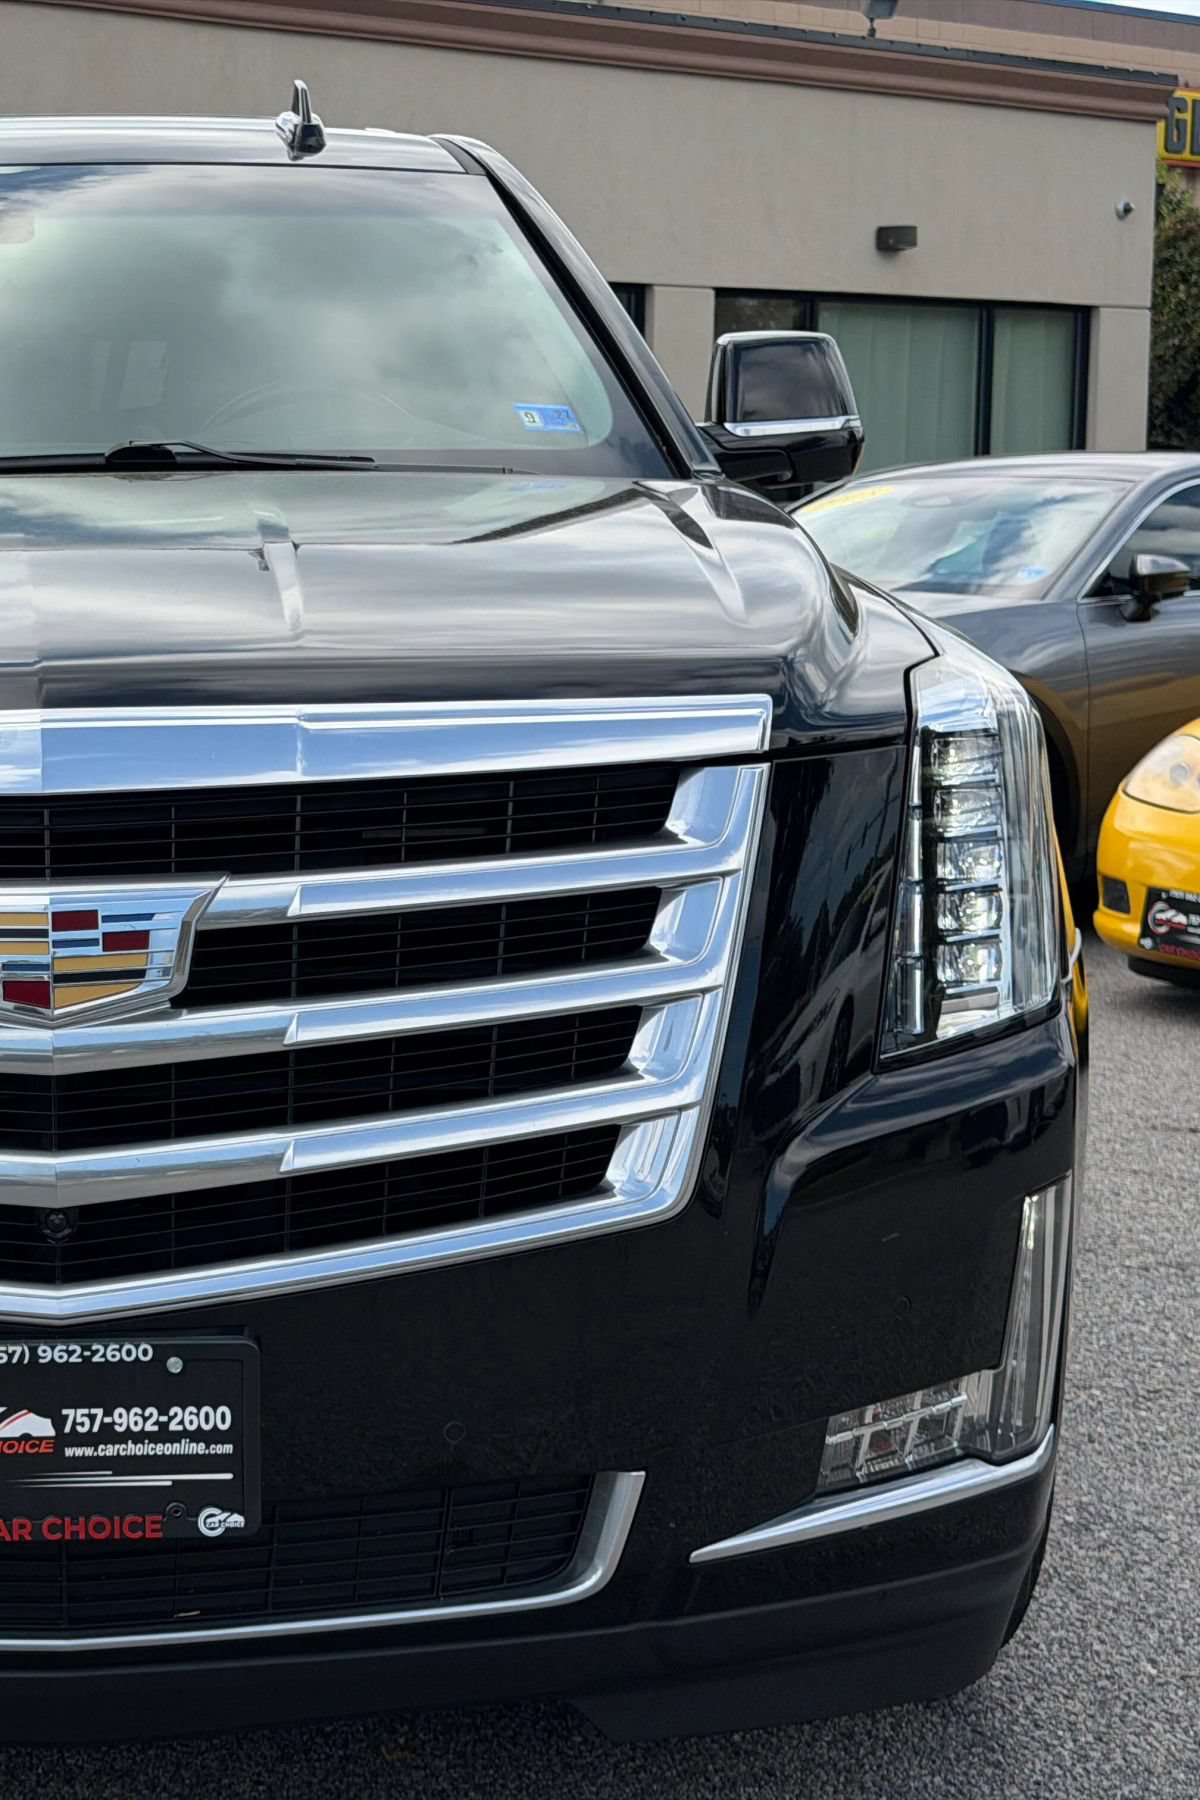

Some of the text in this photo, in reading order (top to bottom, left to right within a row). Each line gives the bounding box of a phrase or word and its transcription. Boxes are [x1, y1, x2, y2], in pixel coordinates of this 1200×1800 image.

[37, 1343, 154, 1364] 962-2600
[61, 1405, 232, 1434] 757-962-2600
[64, 1438, 234, 1458] www.carchoiceonline.com
[41, 1515, 164, 1542] CHOICE
